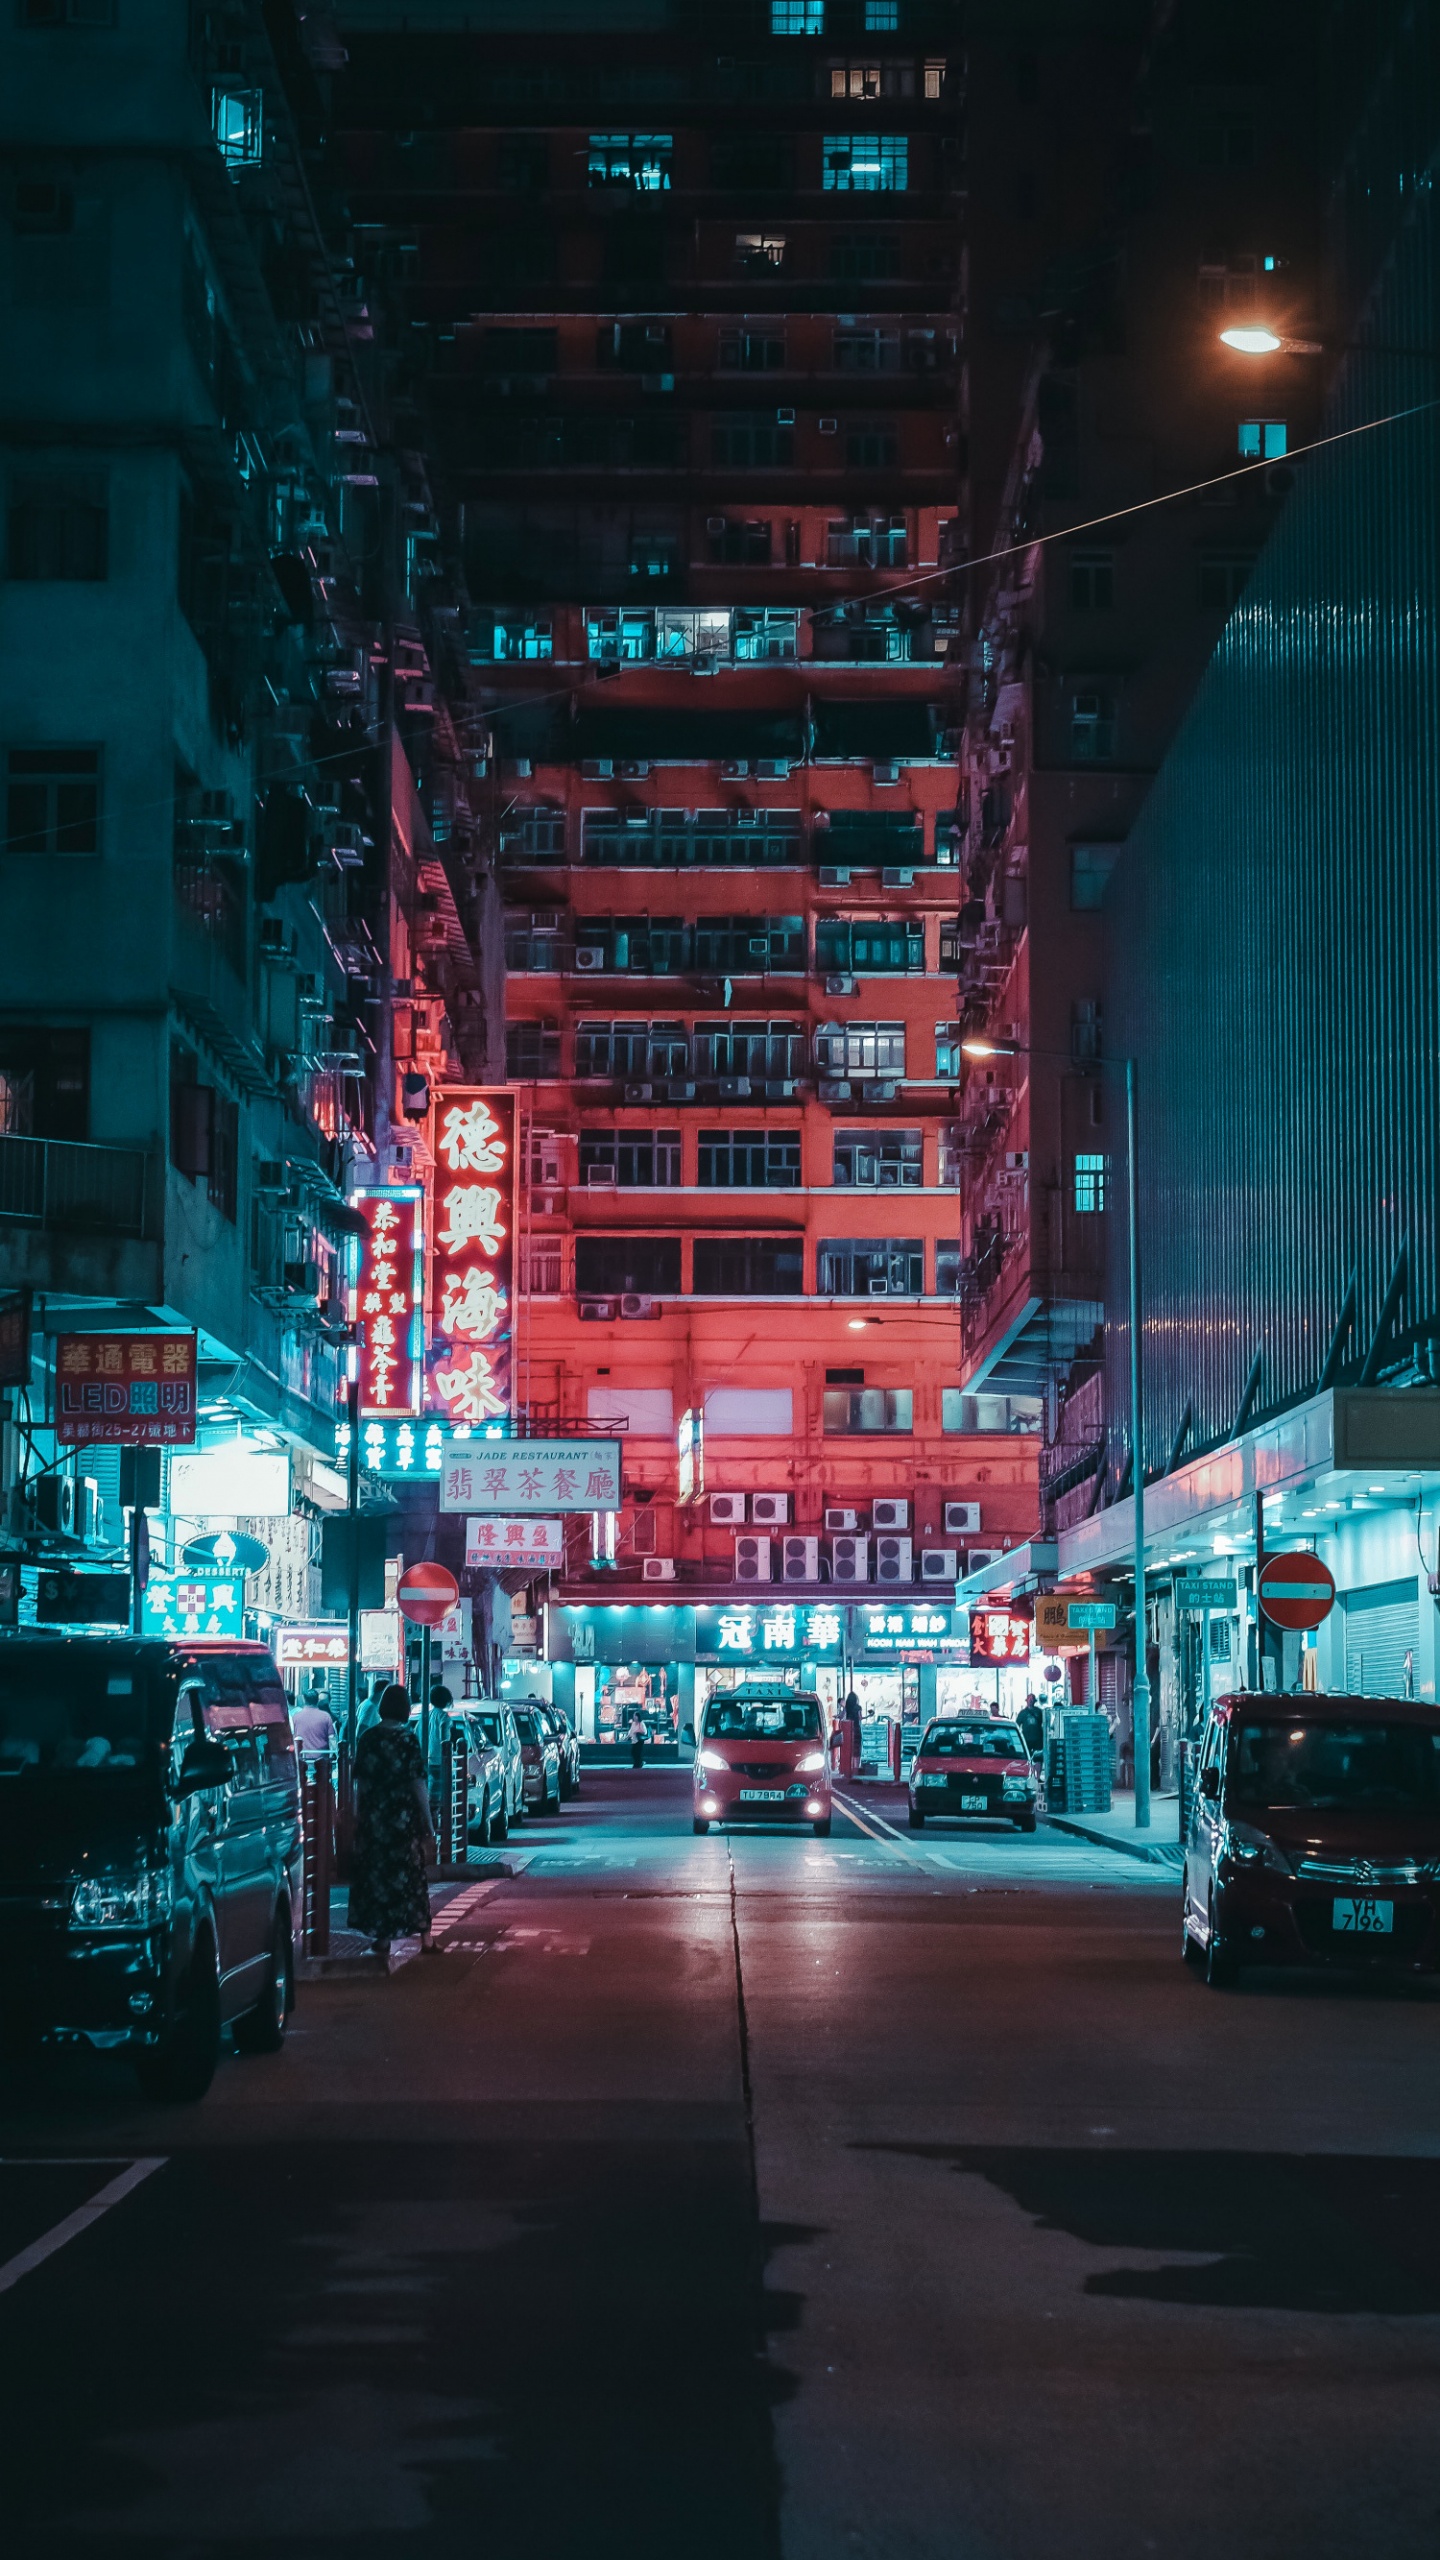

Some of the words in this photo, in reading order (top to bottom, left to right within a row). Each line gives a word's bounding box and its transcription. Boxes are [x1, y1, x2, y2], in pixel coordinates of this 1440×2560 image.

[435, 1101, 508, 1423] 德興海味
[62, 1343, 190, 1374] 華通電器
[62, 1381, 190, 1414] LED照明
[476, 1452, 507, 1460] JADE
[512, 1452, 589, 1460] RESTAURANT
[446, 1467, 616, 1500] 翡翠茶餐廳
[197, 1566, 251, 1577] DESSERTS
[1180, 1582, 1200, 1590] TAXI
[1202, 1582, 1234, 1590] STAND
[1189, 1592, 1225, 1604] 的士站
[717, 1615, 841, 1649] 冠南華
